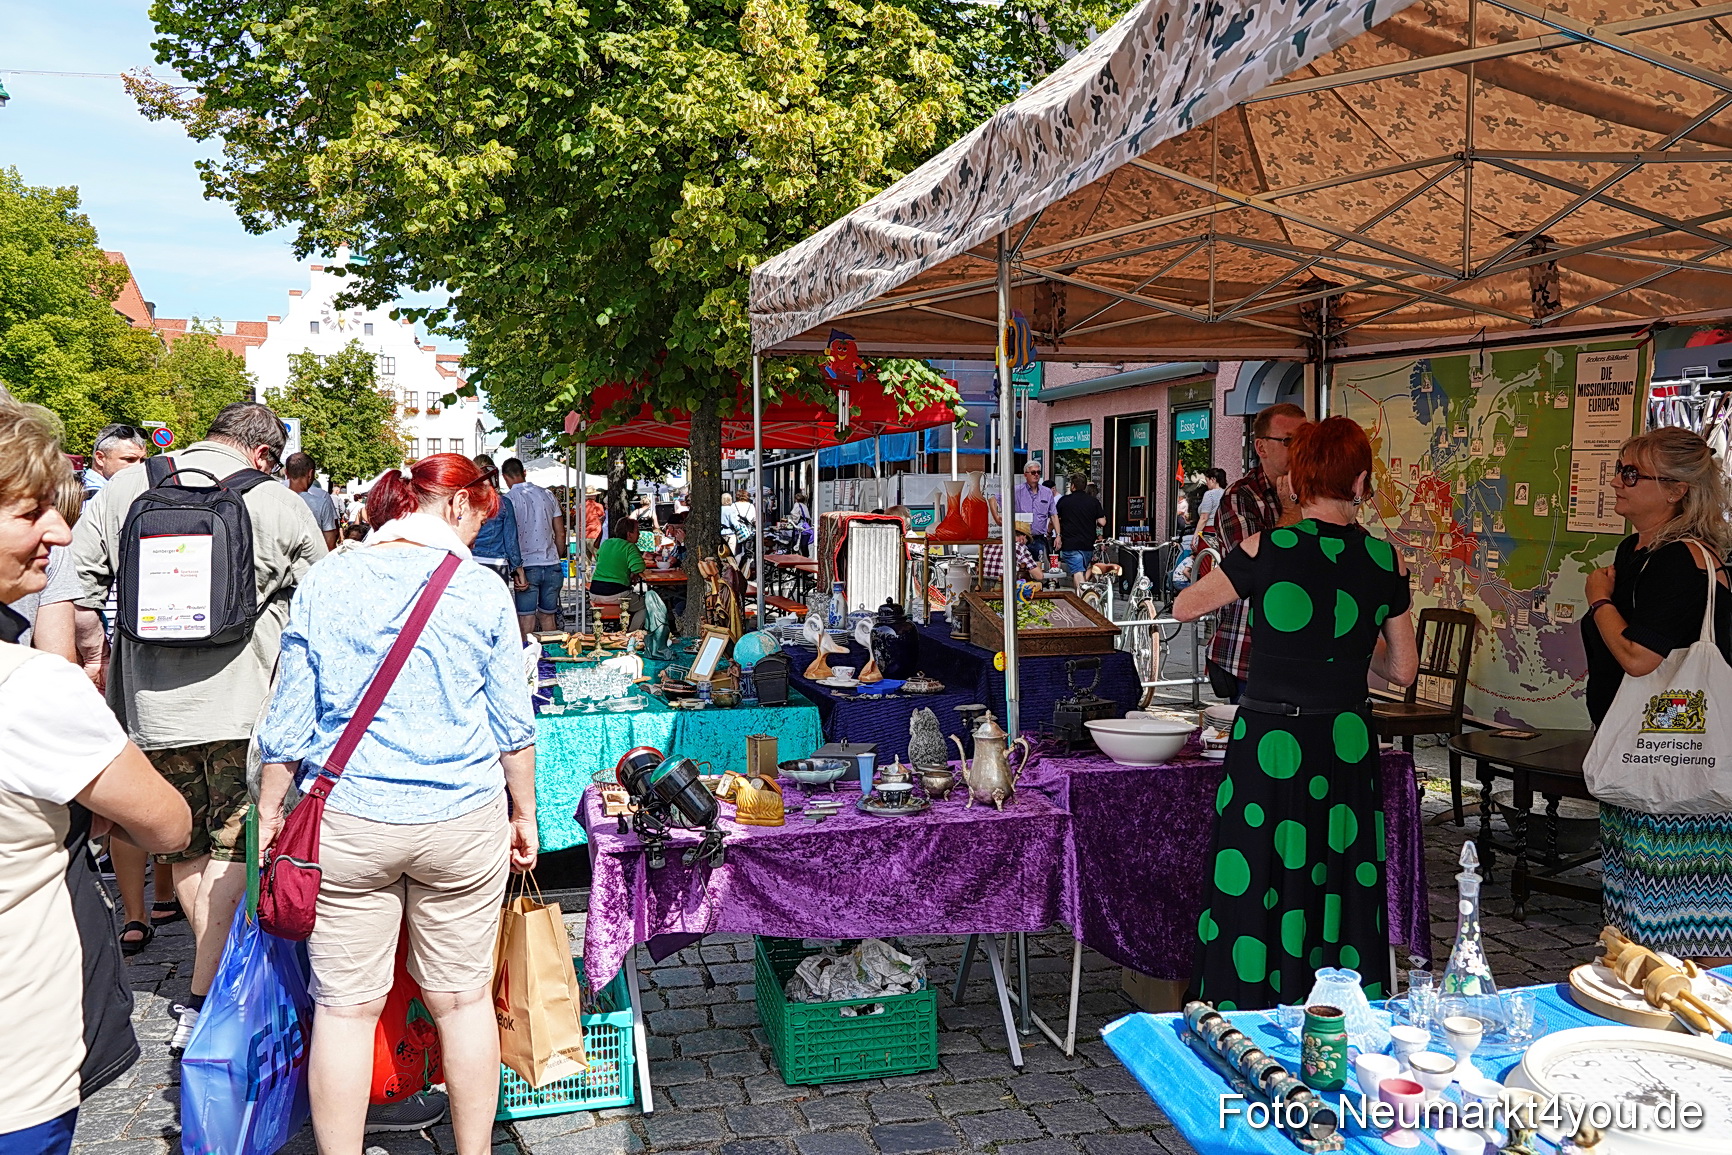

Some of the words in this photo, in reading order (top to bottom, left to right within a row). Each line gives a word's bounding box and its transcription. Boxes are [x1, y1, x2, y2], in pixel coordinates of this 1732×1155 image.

[1601, 366, 1613, 380] DIE
[1577, 381, 1634, 397] MISSIONIERUNG
[1588, 398, 1620, 412] EUROPAS
[1180, 418, 1196, 434] Essig
[1200, 415, 1208, 430] Öl
[1132, 427, 1146, 439] Wein
[914, 514, 932, 525] FASS
[1636, 738, 1703, 752] Bayerische
[1621, 753, 1716, 768] Staatsregierung
